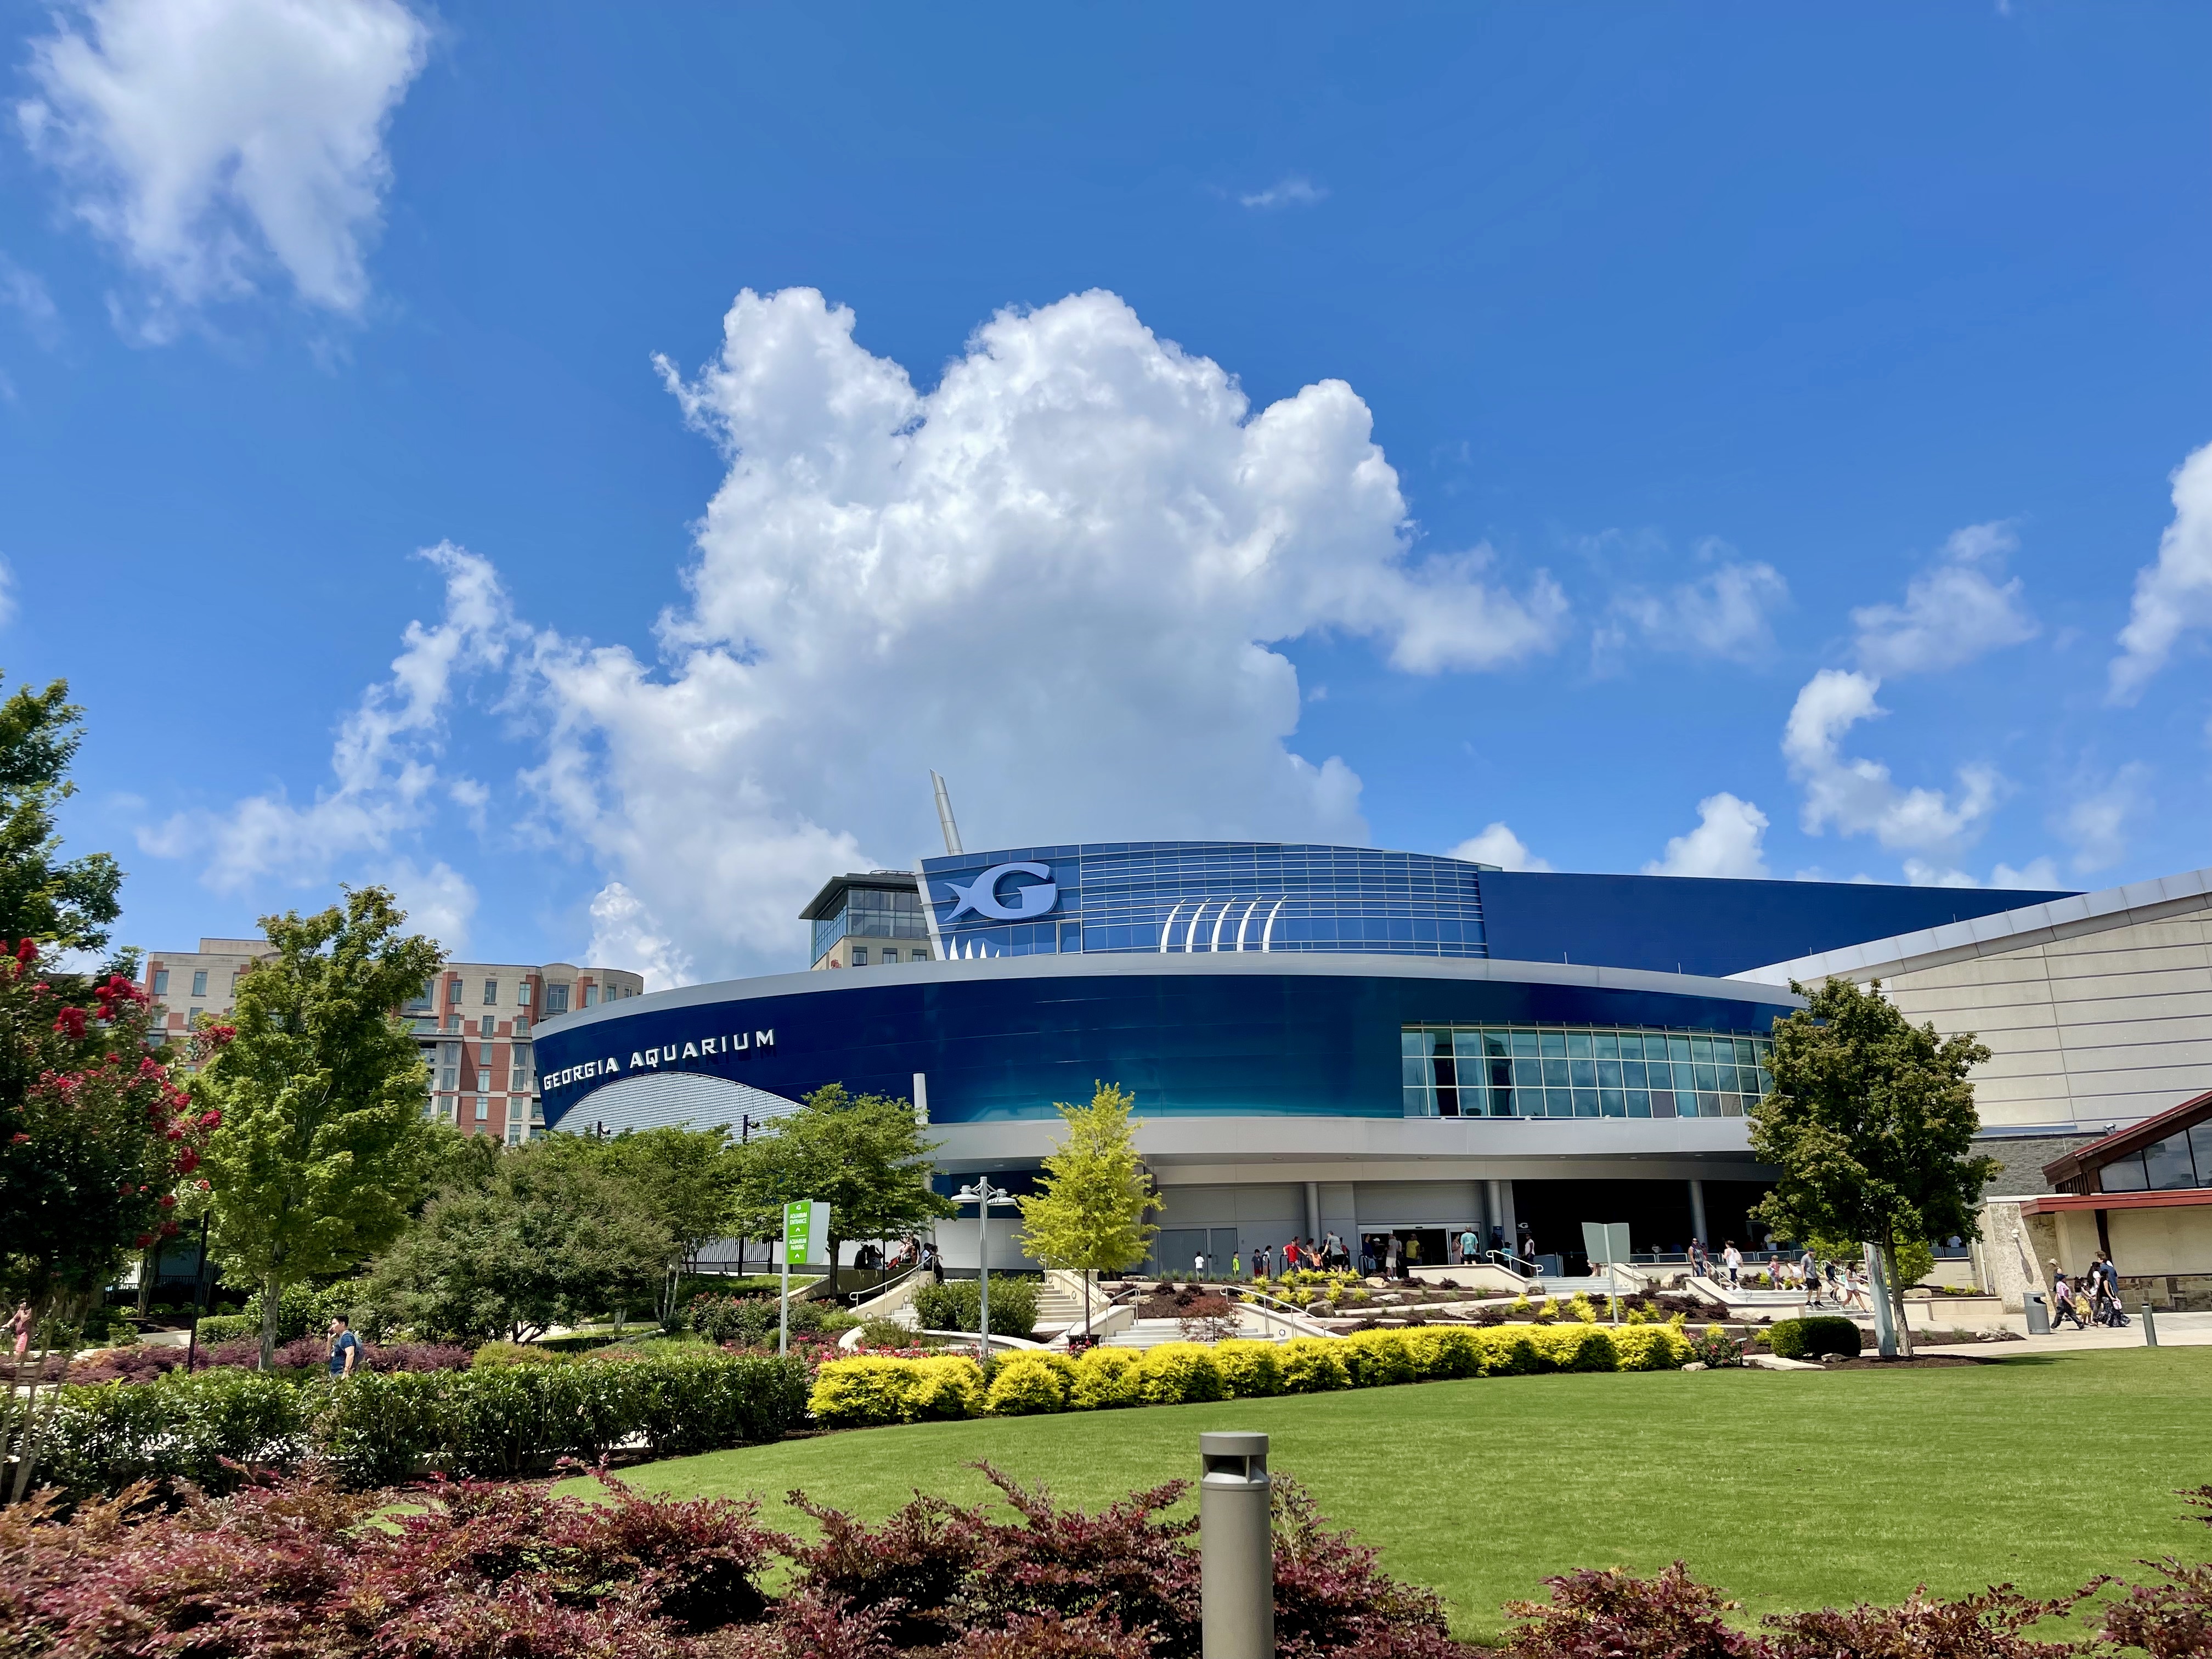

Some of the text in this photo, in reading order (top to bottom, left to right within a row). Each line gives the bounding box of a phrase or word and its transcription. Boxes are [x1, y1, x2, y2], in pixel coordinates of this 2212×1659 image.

[544, 1029, 774, 1090] GEORGIA AQUARIUM
[1875, 1247, 1883, 1285] EMERGENCY
